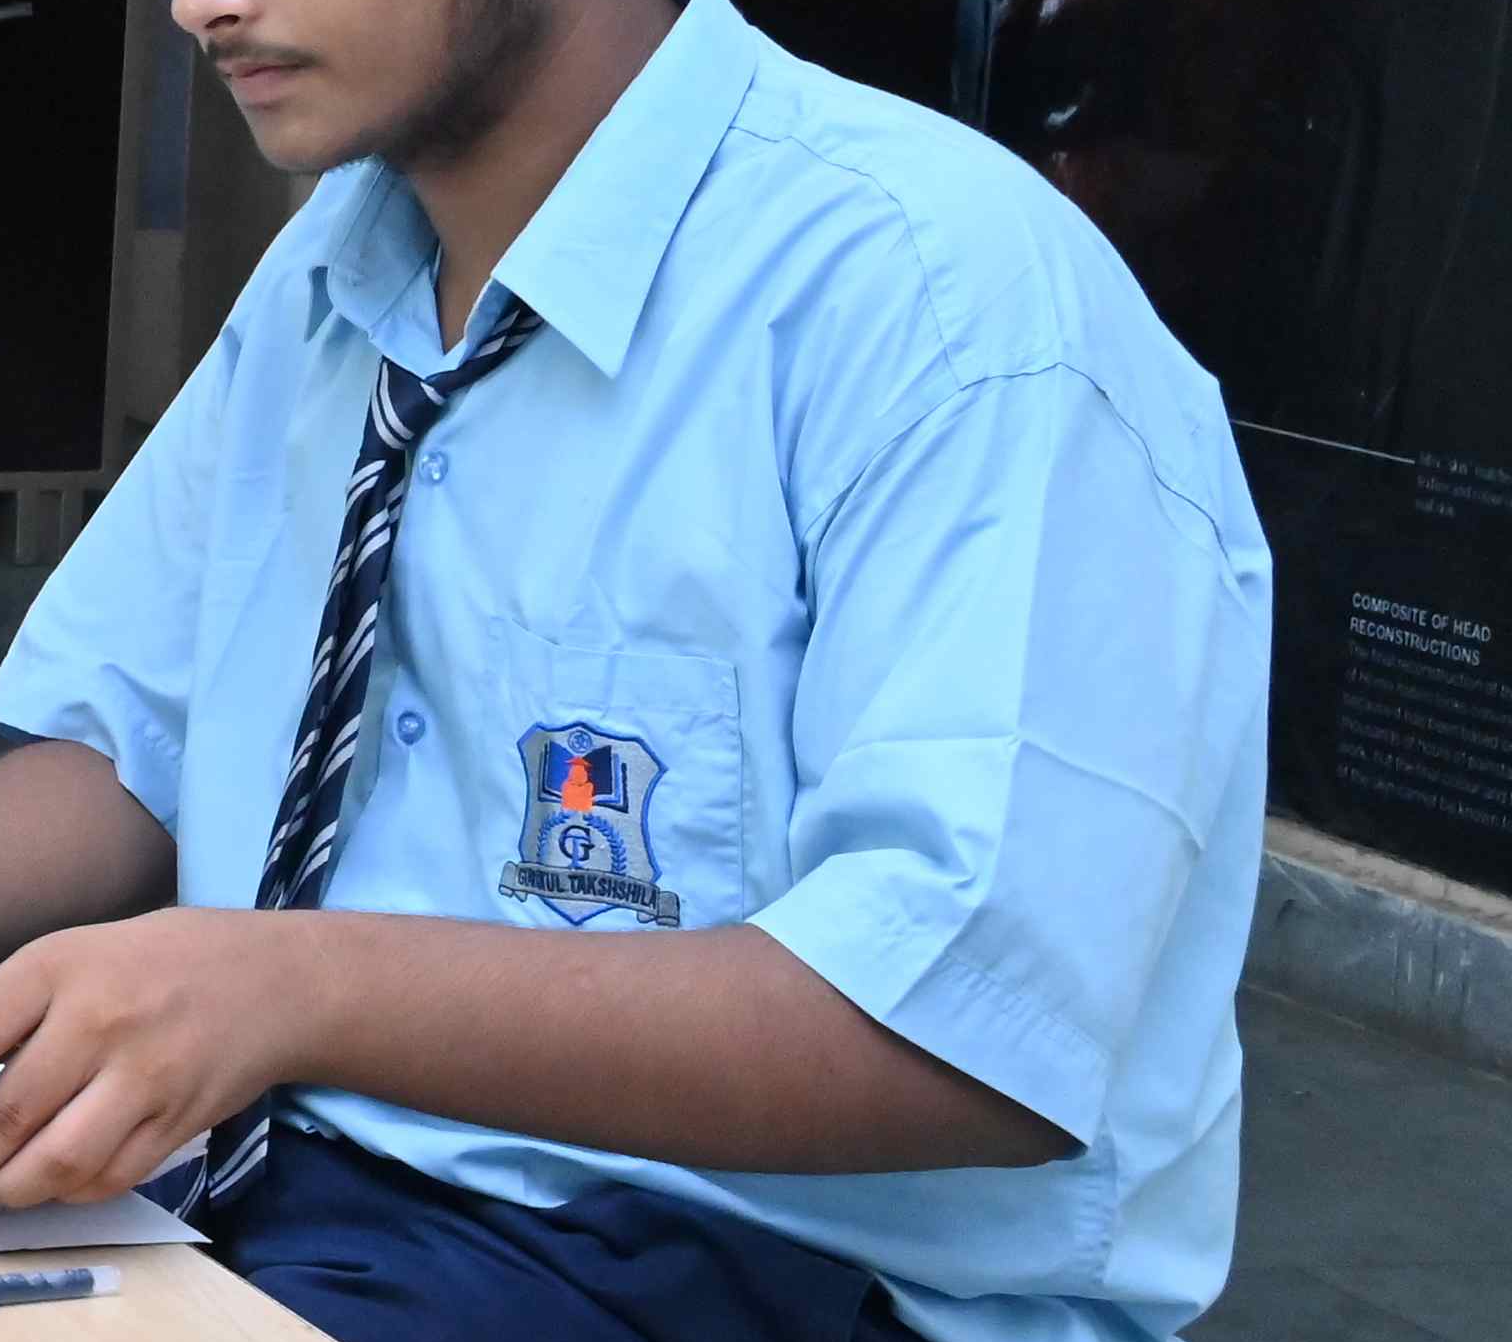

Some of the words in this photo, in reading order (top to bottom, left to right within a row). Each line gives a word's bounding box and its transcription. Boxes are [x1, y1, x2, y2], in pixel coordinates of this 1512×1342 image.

[1350, 616, 1480, 666] RECONSTRUCTIONS
[1352, 592, 1427, 626] COMPOSITE
[1431, 613, 1449, 630] OF
[1453, 619, 1492, 642] HEAD
